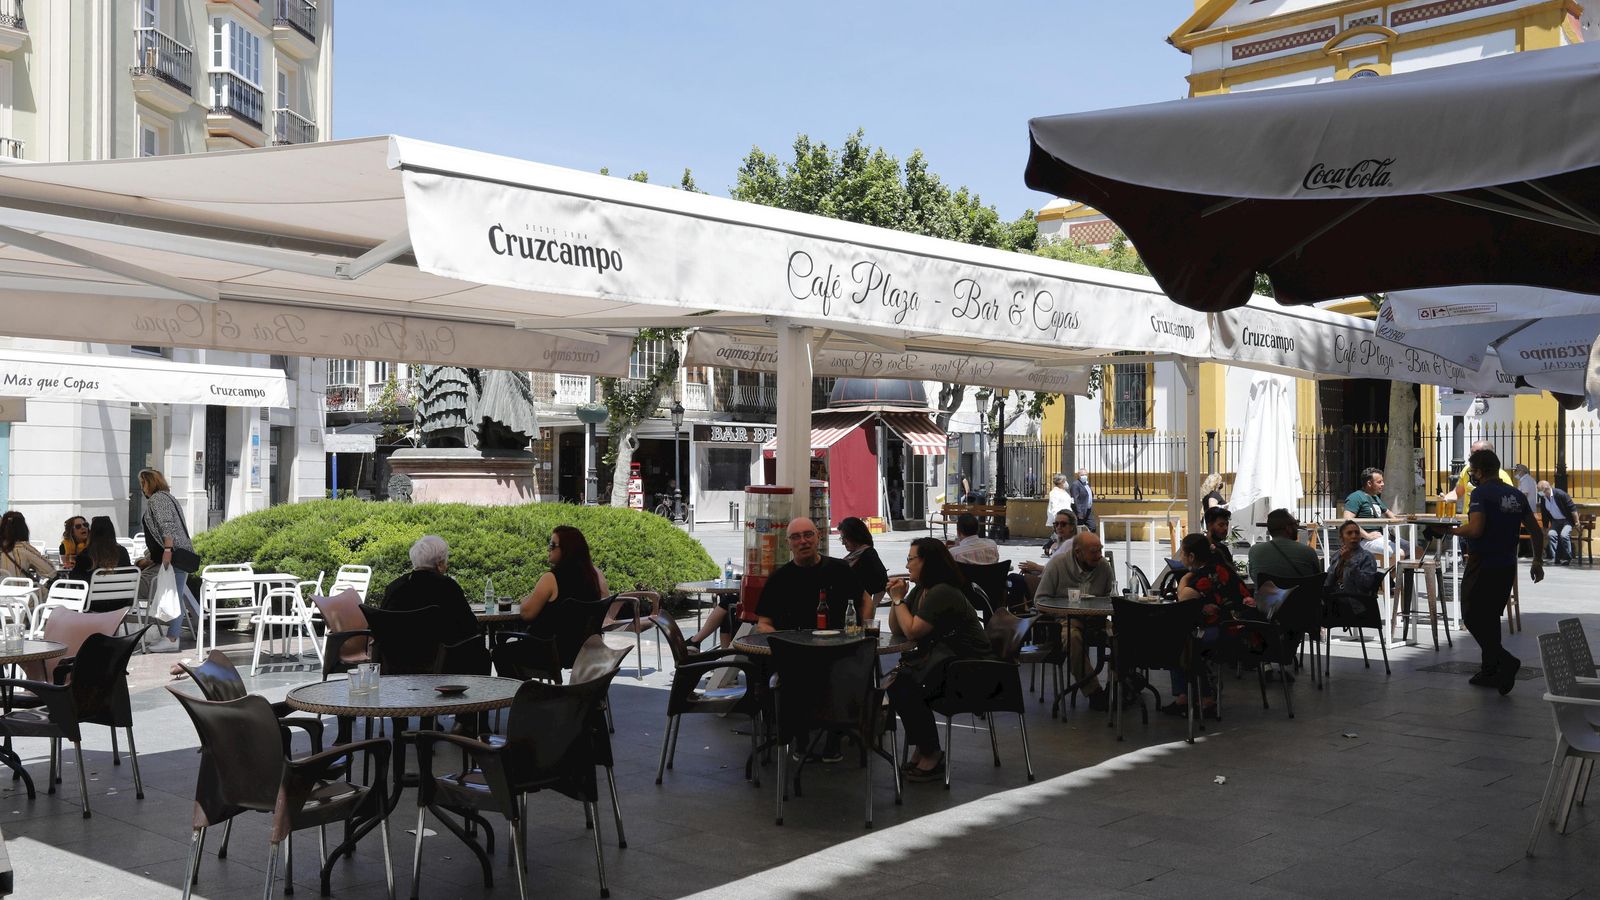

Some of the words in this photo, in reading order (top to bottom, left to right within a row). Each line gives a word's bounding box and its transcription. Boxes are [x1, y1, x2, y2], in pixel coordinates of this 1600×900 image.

[1302, 158, 1397, 190] Coca-Cola
[488, 222, 623, 274] Cruzcampo
[787, 248, 843, 316] Café
[851, 260, 920, 325] Plaza
[952, 278, 1000, 321] Bar
[1008, 290, 1026, 326] &
[1032, 289, 1081, 340] Copas
[1150, 315, 1195, 342] Cruzcampo
[1242, 326, 1295, 354] Cruzcampo
[1334, 334, 1357, 373] Café
[1359, 339, 1395, 376] Plaza
[1404, 346, 1430, 374] Bar
[3, 373, 33, 387] Más
[36, 377, 59, 391] que
[63, 376, 100, 393] Copas
[209, 383, 266, 398] Cruzcampo
[711, 426, 748, 442] BAR
